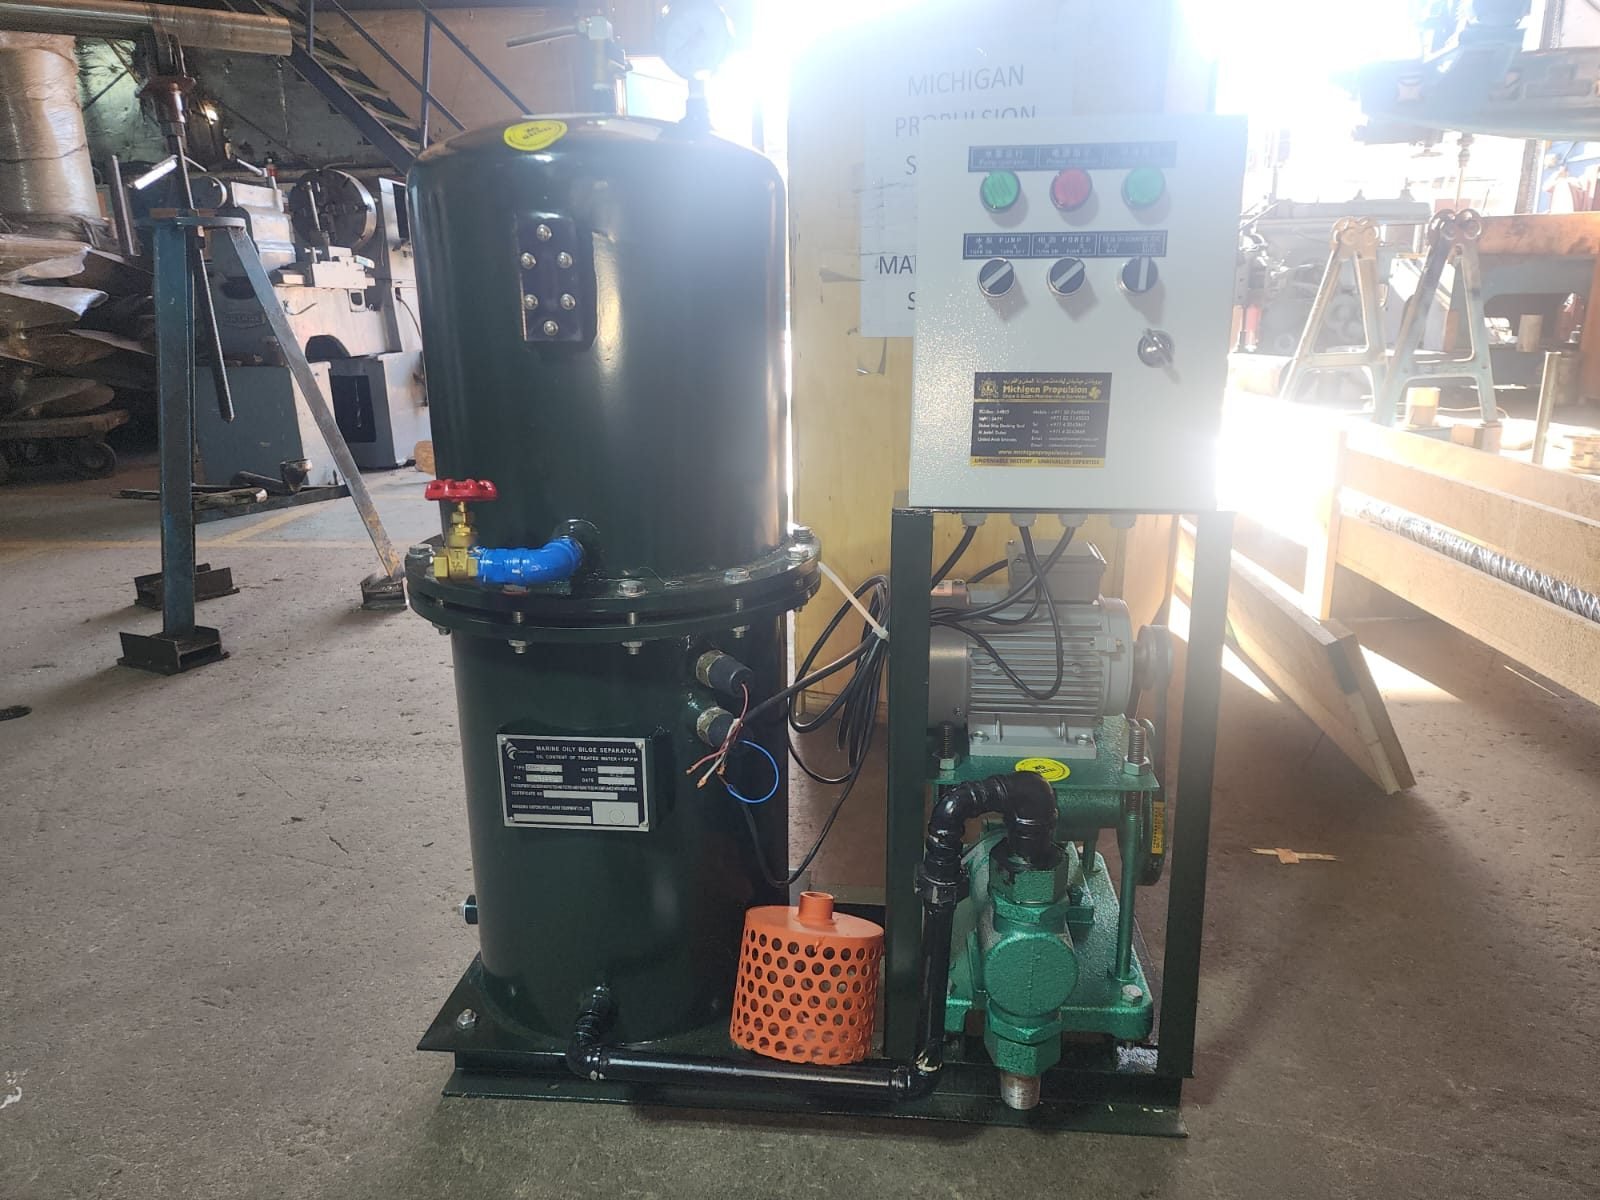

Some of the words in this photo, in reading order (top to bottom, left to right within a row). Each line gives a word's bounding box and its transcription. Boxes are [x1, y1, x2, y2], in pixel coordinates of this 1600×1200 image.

[908, 64, 1024, 97] MICHIGAN
[879, 255, 917, 275] MA
[1003, 384, 1041, 395] Michigan
[1043, 385, 1088, 395] Propulsion
